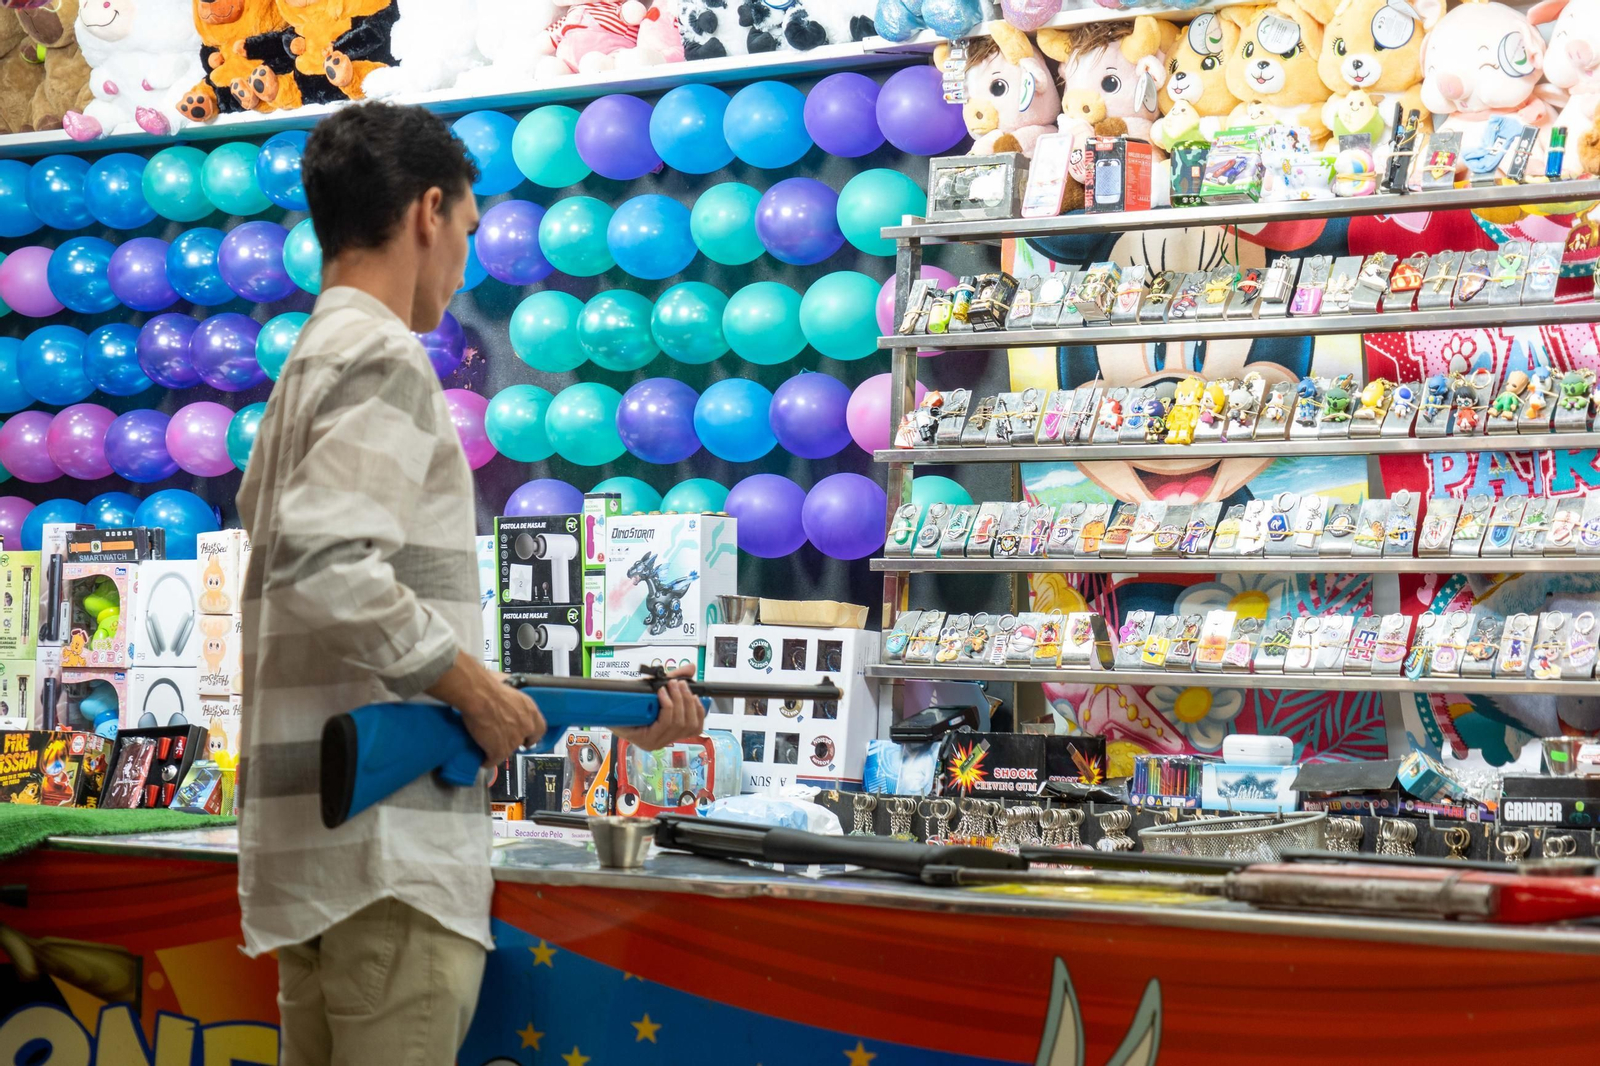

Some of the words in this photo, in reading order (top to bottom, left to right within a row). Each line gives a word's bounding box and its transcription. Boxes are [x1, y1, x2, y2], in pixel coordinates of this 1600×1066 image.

[500, 522, 520, 530] PISTOLA
[527, 521, 547, 529] MASAJE
[79, 553, 127, 562] SMARTWATCH
[503, 612, 522, 620] PISTOLA
[606, 661, 630, 669] WIRELESS
[993, 767, 1038, 780] SHOCK
[974, 780, 1014, 791] CHEWING
[1015, 782, 1038, 793] GUM
[1329, 800, 1342, 811] LED
[1504, 801, 1563, 822] GRINDER
[514, 828, 541, 838] Secador
[541, 830, 549, 838] de
[550, 830, 564, 839] Pelo
